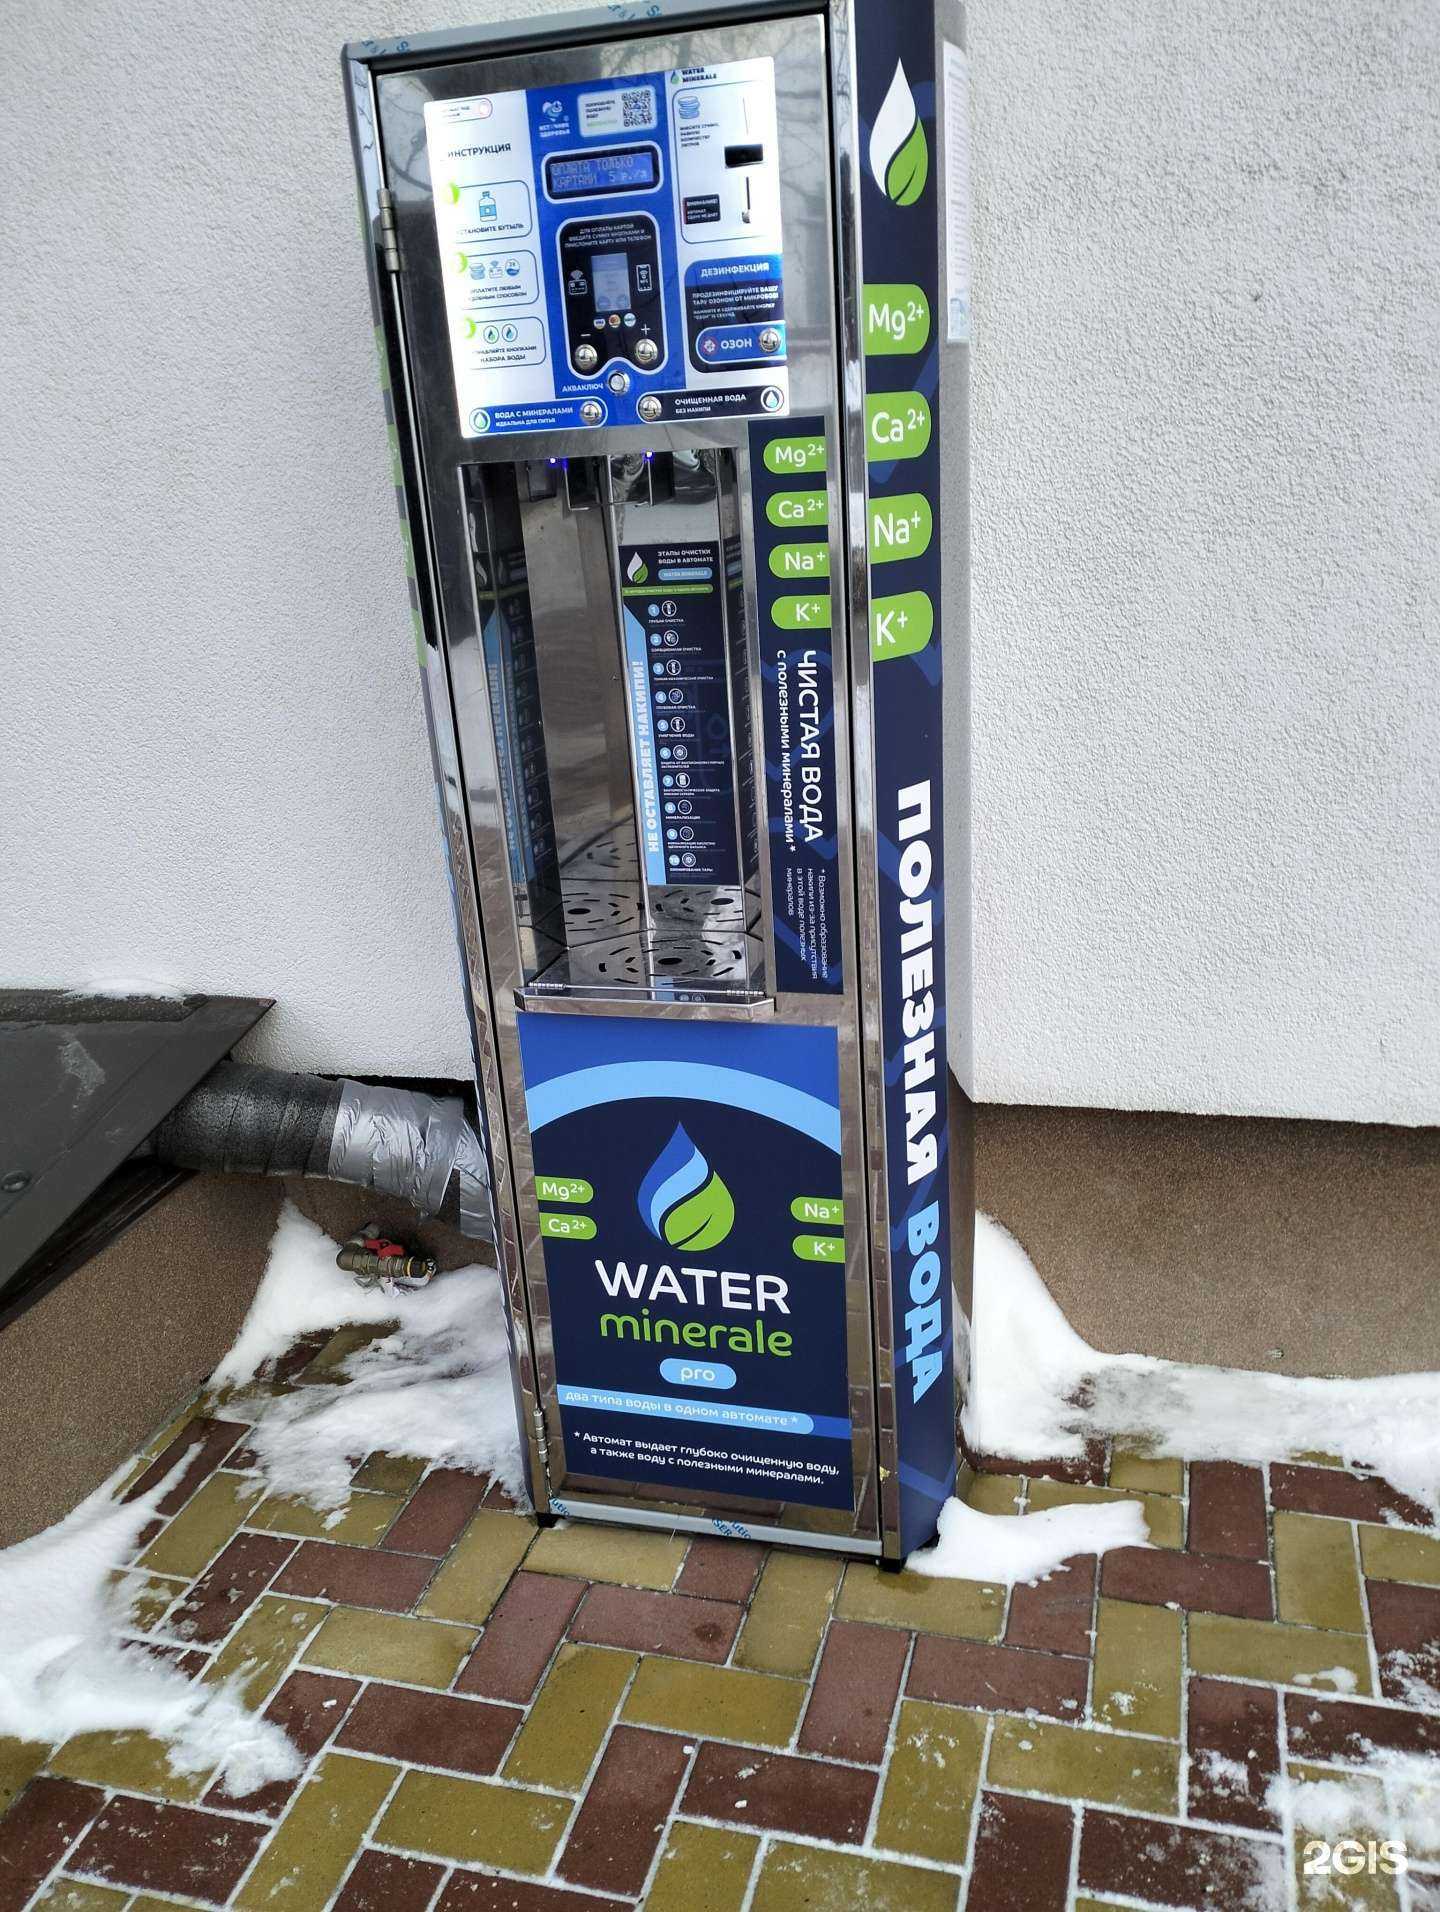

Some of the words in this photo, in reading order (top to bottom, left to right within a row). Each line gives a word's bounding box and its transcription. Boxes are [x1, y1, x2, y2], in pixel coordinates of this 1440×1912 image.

[700, 262, 770, 277] ДЕЗИНФЕКЦИЯ
[720, 338, 752, 350] ОЗОН
[562, 383, 604, 393] АКВАКЛЮЧ
[674, 395, 723, 406] ОЧИЩЕННАЯ
[724, 392, 747, 402] ВОДА
[495, 411, 515, 420] ВОДА
[522, 407, 573, 417] МИНЕРАЛАМИ
[777, 650, 786, 659] с
[632, 661, 649, 735] НАКИПИ!
[777, 662, 792, 750] полезными
[797, 650, 821, 759] ЧИСТАЯ
[640, 739, 657, 831] ОСТАВЛЯЕТ
[799, 767, 822, 843] ВОДА
[648, 832, 659, 852] НЕ
[897, 779, 939, 1187] ПОЛЕЗНАЯ
[595, 1259, 791, 1314] WATER
[906, 1199, 943, 1406] ВОДА
[600, 1308, 793, 1357] minerale
[680, 1365, 716, 1384] pro
[565, 1391, 589, 1402] два
[591, 1393, 623, 1407] типа
[625, 1397, 661, 1411] воды
[664, 1402, 672, 1412] в
[675, 1404, 719, 1418] одном
[721, 1410, 788, 1427] автомате
[583, 1432, 632, 1448] Автомат
[635, 1439, 678, 1453] выдает
[680, 1445, 729, 1460] глубоко
[730, 1451, 804, 1470] очищенную
[806, 1462, 840, 1476] воду,
[590, 1447, 597, 1455] а
[599, 1448, 635, 1460] также
[637, 1453, 666, 1465] воду
[668, 1456, 675, 1465] с
[677, 1458, 743, 1474] полезными
[746, 1465, 824, 1485] минералами.
